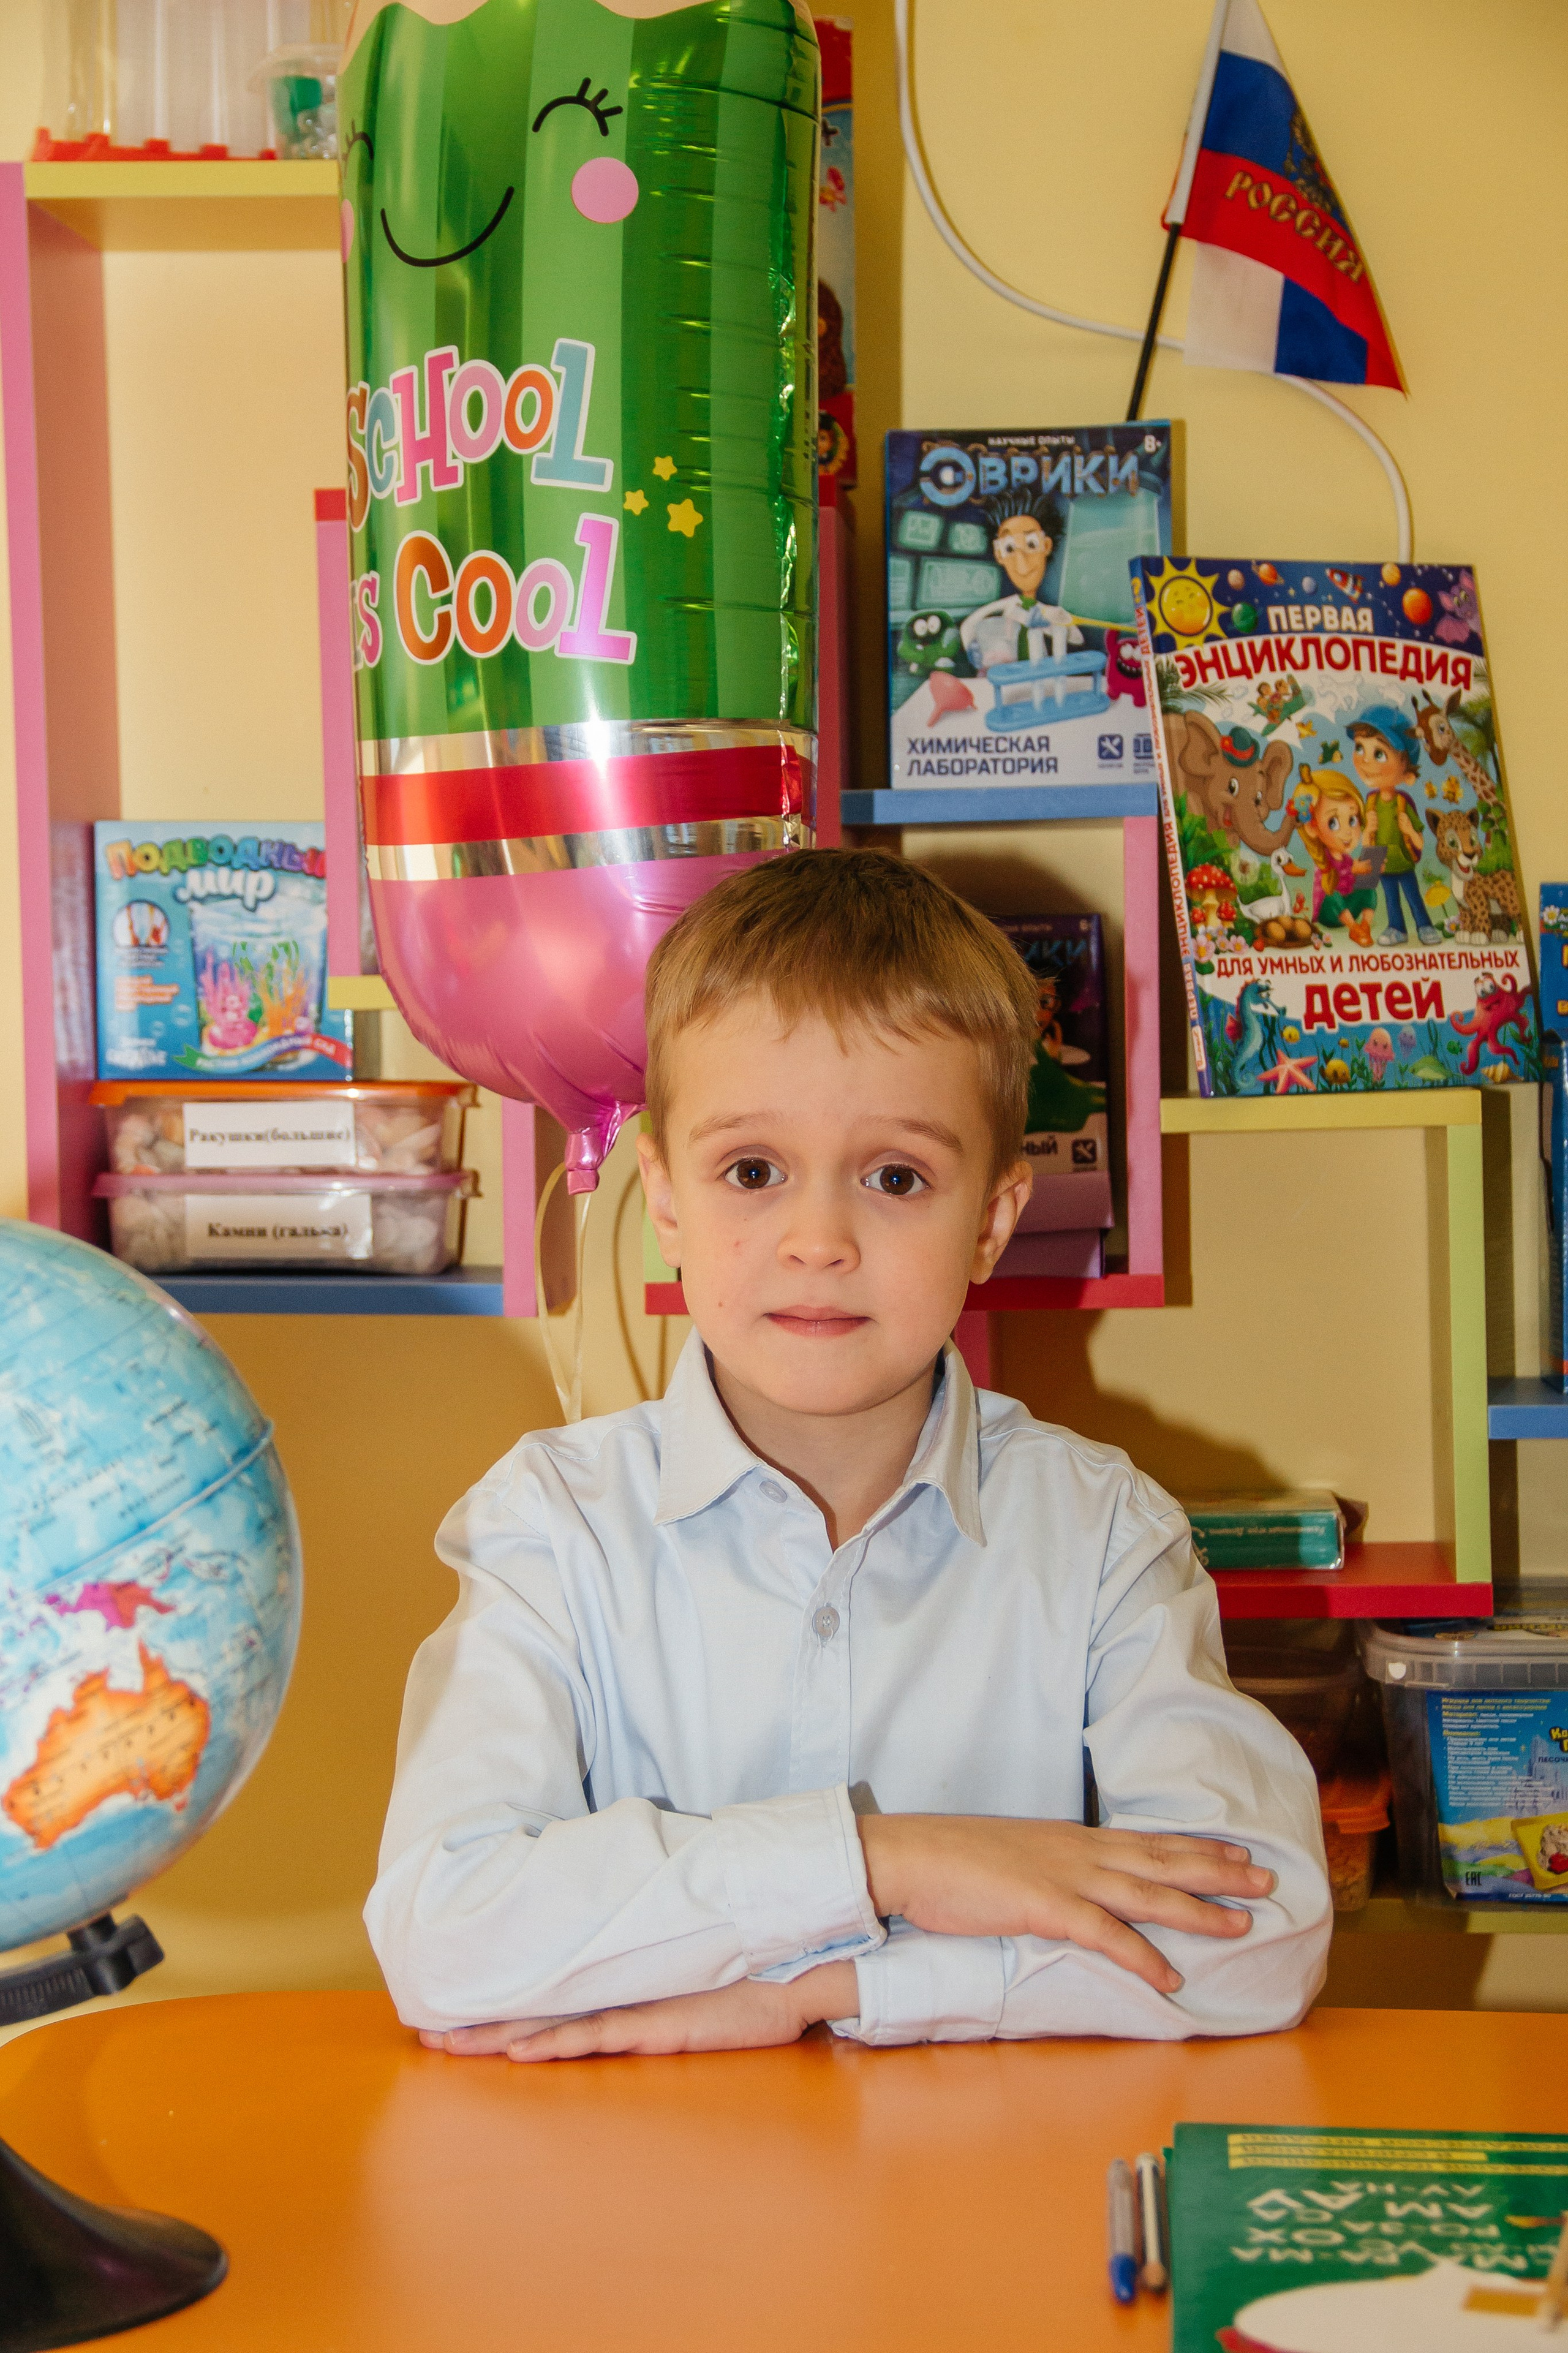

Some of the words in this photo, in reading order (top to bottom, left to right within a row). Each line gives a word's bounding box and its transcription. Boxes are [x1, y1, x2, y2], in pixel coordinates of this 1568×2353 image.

[1224, 170, 1365, 284] РОССИЯ
[919, 447, 1139, 508] ЭВРИКИ
[1267, 605, 1374, 634] ПЕРВАЯ
[1175, 635, 1472, 691] ЭНЦИКЛОПЕДИЯ
[907, 735, 1050, 755] ХИМИЧЕСКАЯ
[907, 757, 1058, 777] ЛАБОРАТОРИЯ
[1163, 821, 1191, 958] ЭНЦИКЛОПЕДИЯ
[1216, 957, 1253, 978] ДЛЯ
[1257, 954, 1325, 975] УМНЫХ
[1329, 954, 1343, 973] И
[1348, 950, 1520, 973] ЛЮБОЗНАТЕЛЬНЫХ
[1184, 962, 1199, 1019] ПЕРВАЯ
[208, 1223, 266, 1237] Камни
